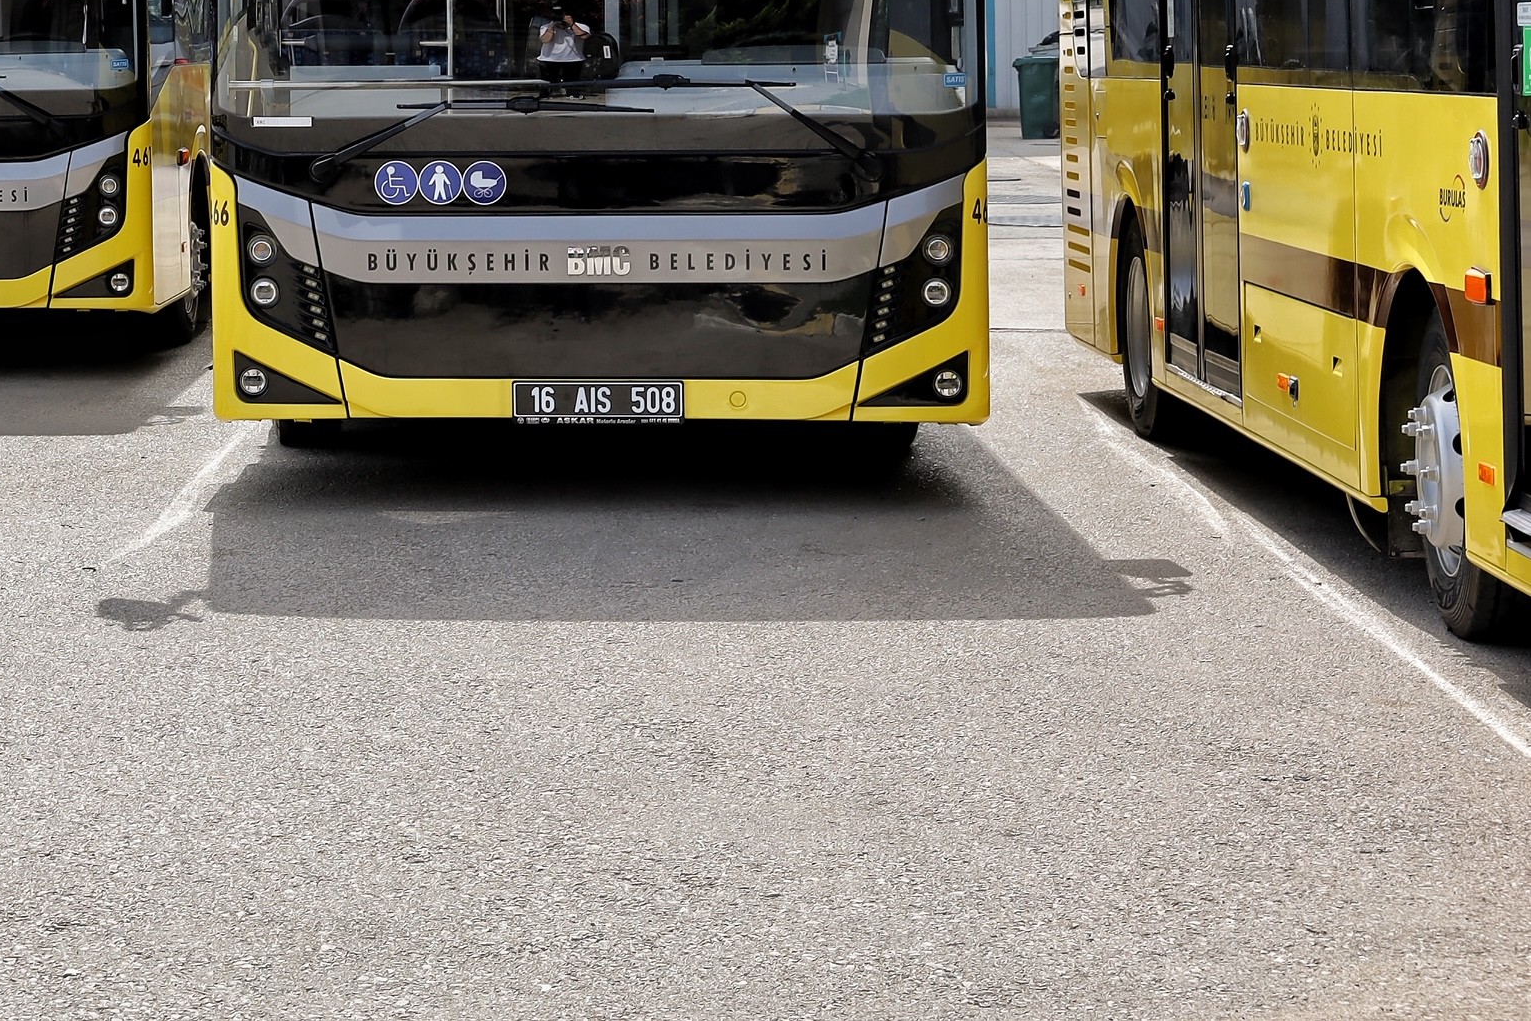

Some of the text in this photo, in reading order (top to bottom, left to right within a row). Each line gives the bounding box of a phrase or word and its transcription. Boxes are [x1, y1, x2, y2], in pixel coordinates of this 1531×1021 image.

[1255, 118, 1383, 158] BÜYÜKŞEHİR BELEDİYESİ
[1439, 187, 1466, 213] BURULAŞ
[367, 245, 827, 277] BÜYÜKŞEHİR BMC BELEDİYESİ
[531, 386, 676, 414] 16 AIS 508
